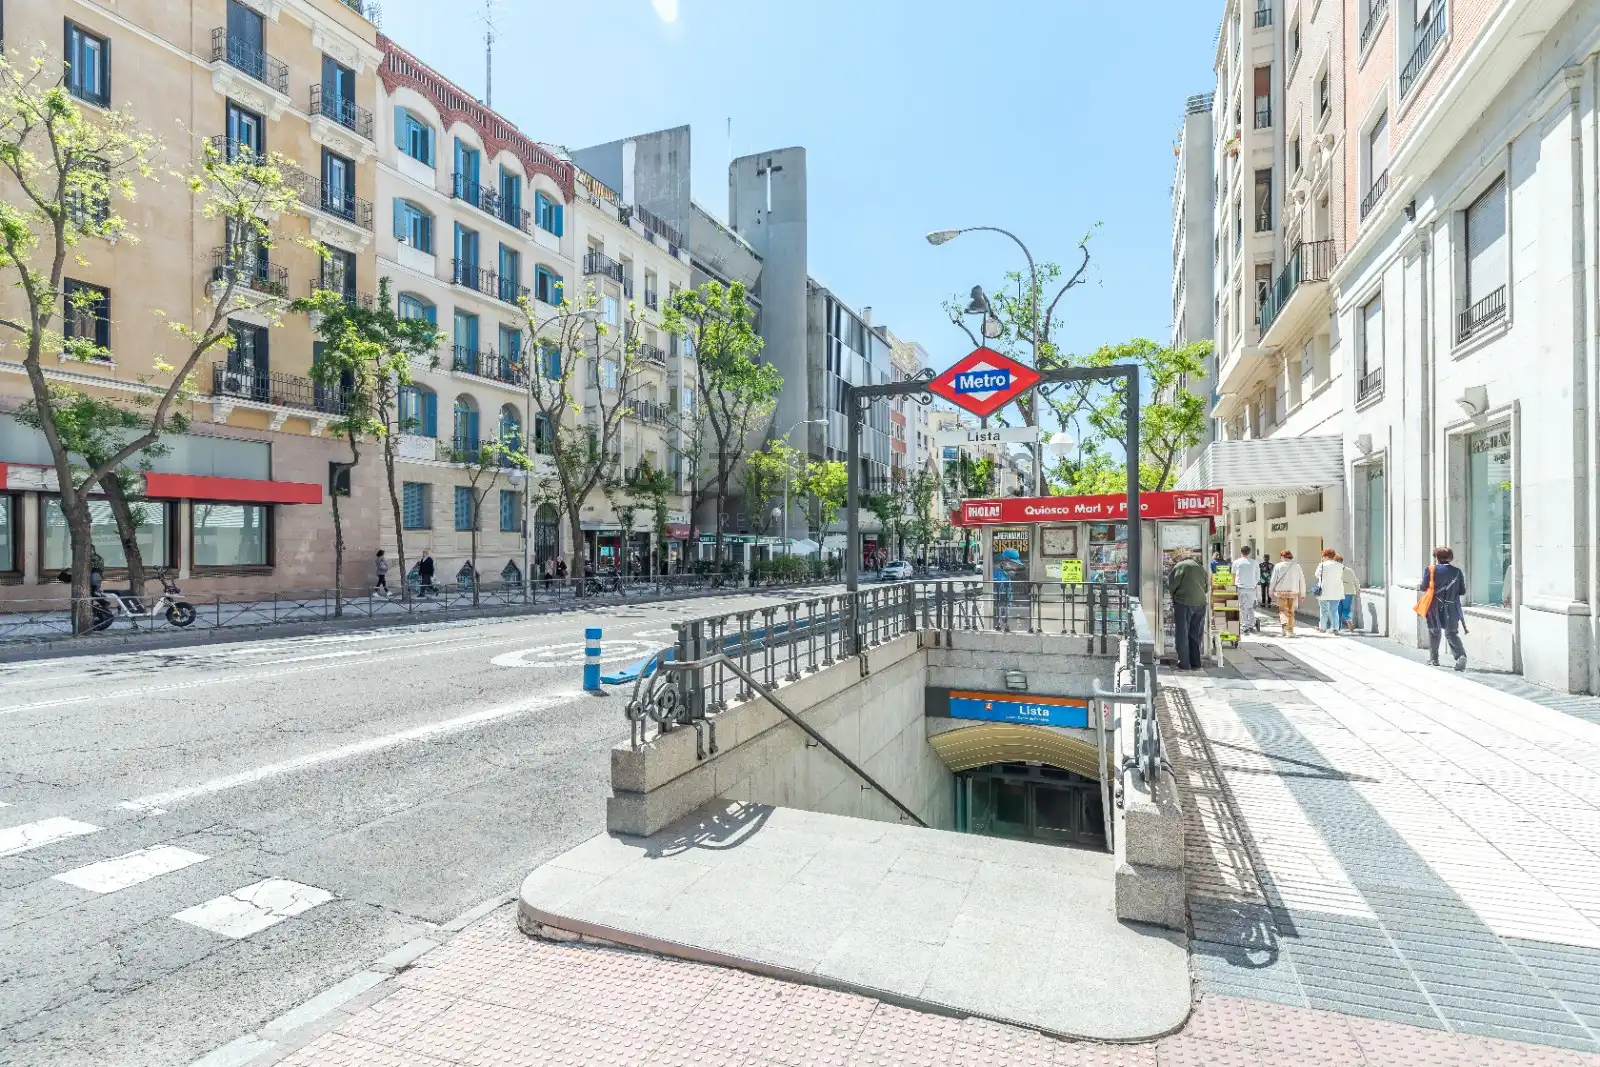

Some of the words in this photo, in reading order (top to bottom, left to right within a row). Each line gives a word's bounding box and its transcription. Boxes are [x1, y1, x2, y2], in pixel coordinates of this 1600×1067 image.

[959, 374, 1006, 390] Metro
[967, 431, 1001, 442] Lista
[1024, 505, 1070, 516] Quiosco
[1106, 505, 1115, 514] y
[1119, 502, 1149, 512] Po
[1177, 496, 1215, 510] ¡HOLA!
[993, 540, 1029, 552] SISTERS
[1019, 705, 1050, 716] Lista
